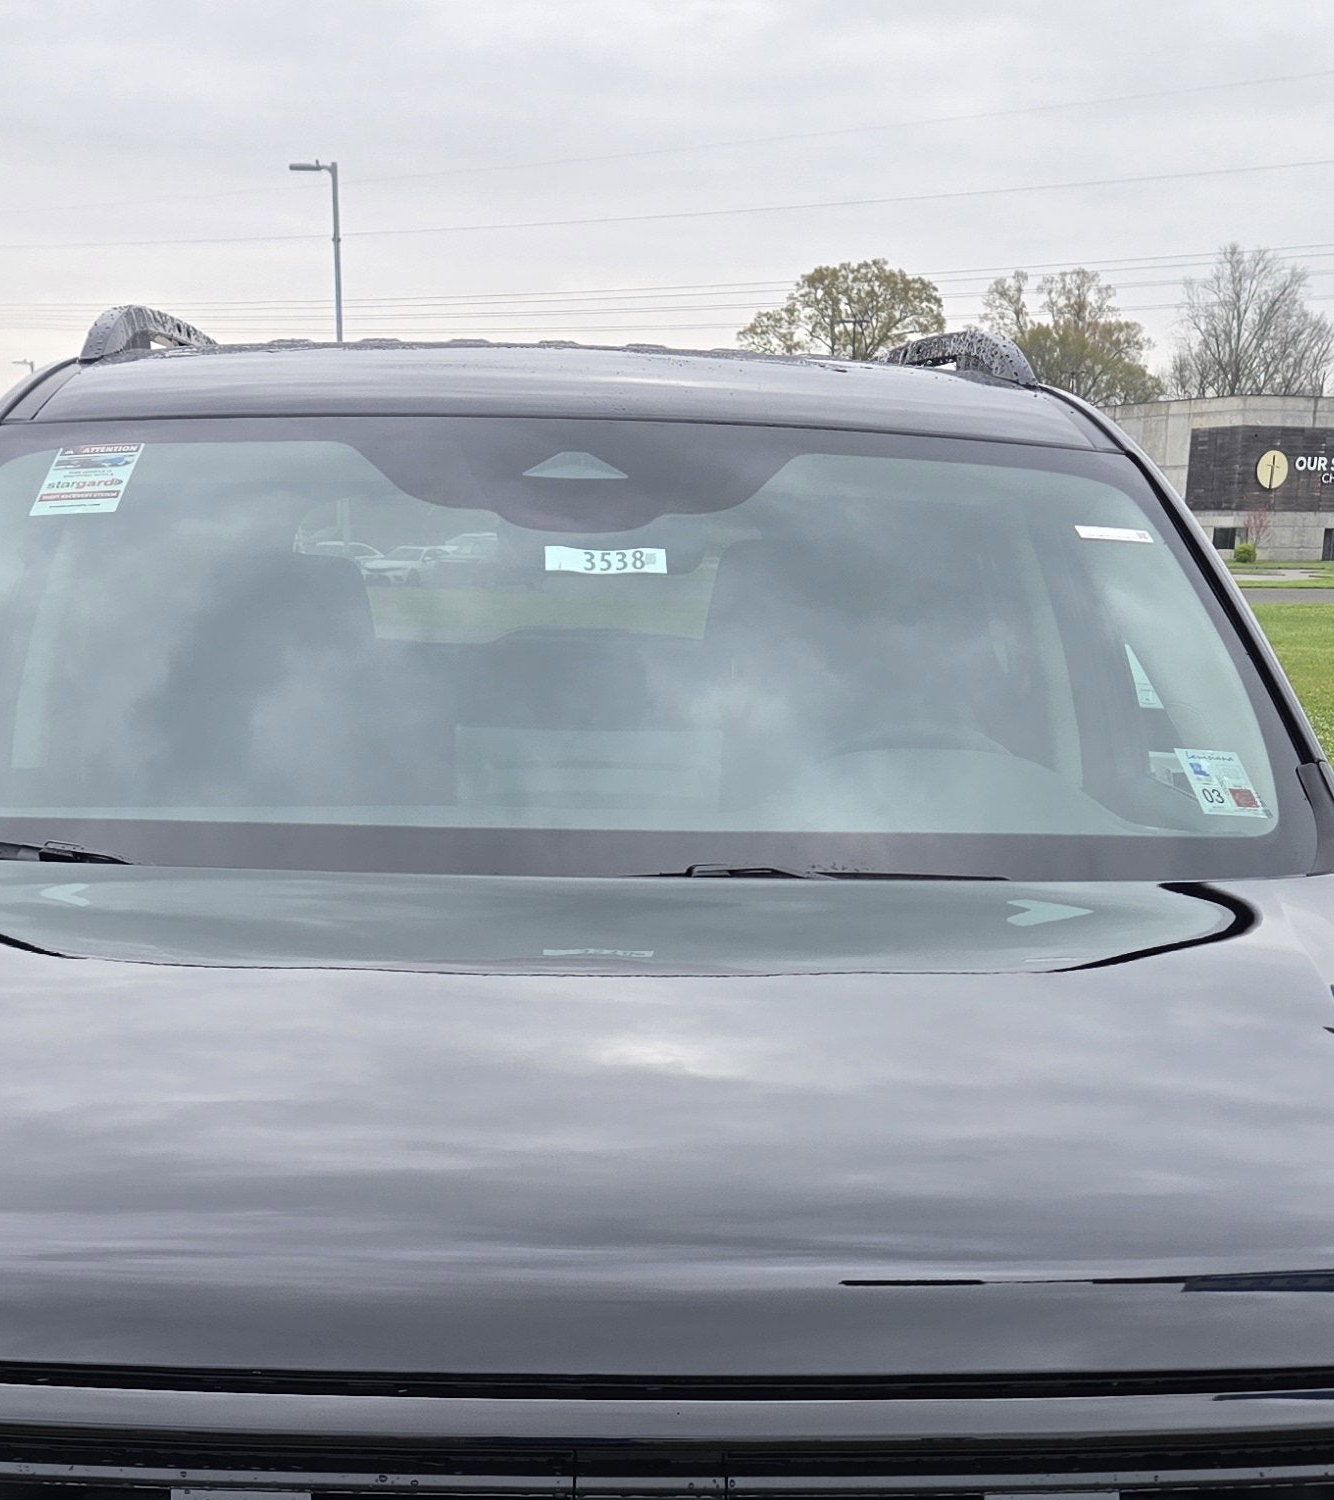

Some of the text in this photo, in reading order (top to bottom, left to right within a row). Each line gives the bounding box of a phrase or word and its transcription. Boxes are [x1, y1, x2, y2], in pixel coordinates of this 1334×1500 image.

[82, 445, 139, 454] ATTENTION
[1295, 456, 1328, 471] OUR
[47, 478, 115, 489] stargard
[583, 550, 646, 571] 3538
[1202, 788, 1225, 804] 03
